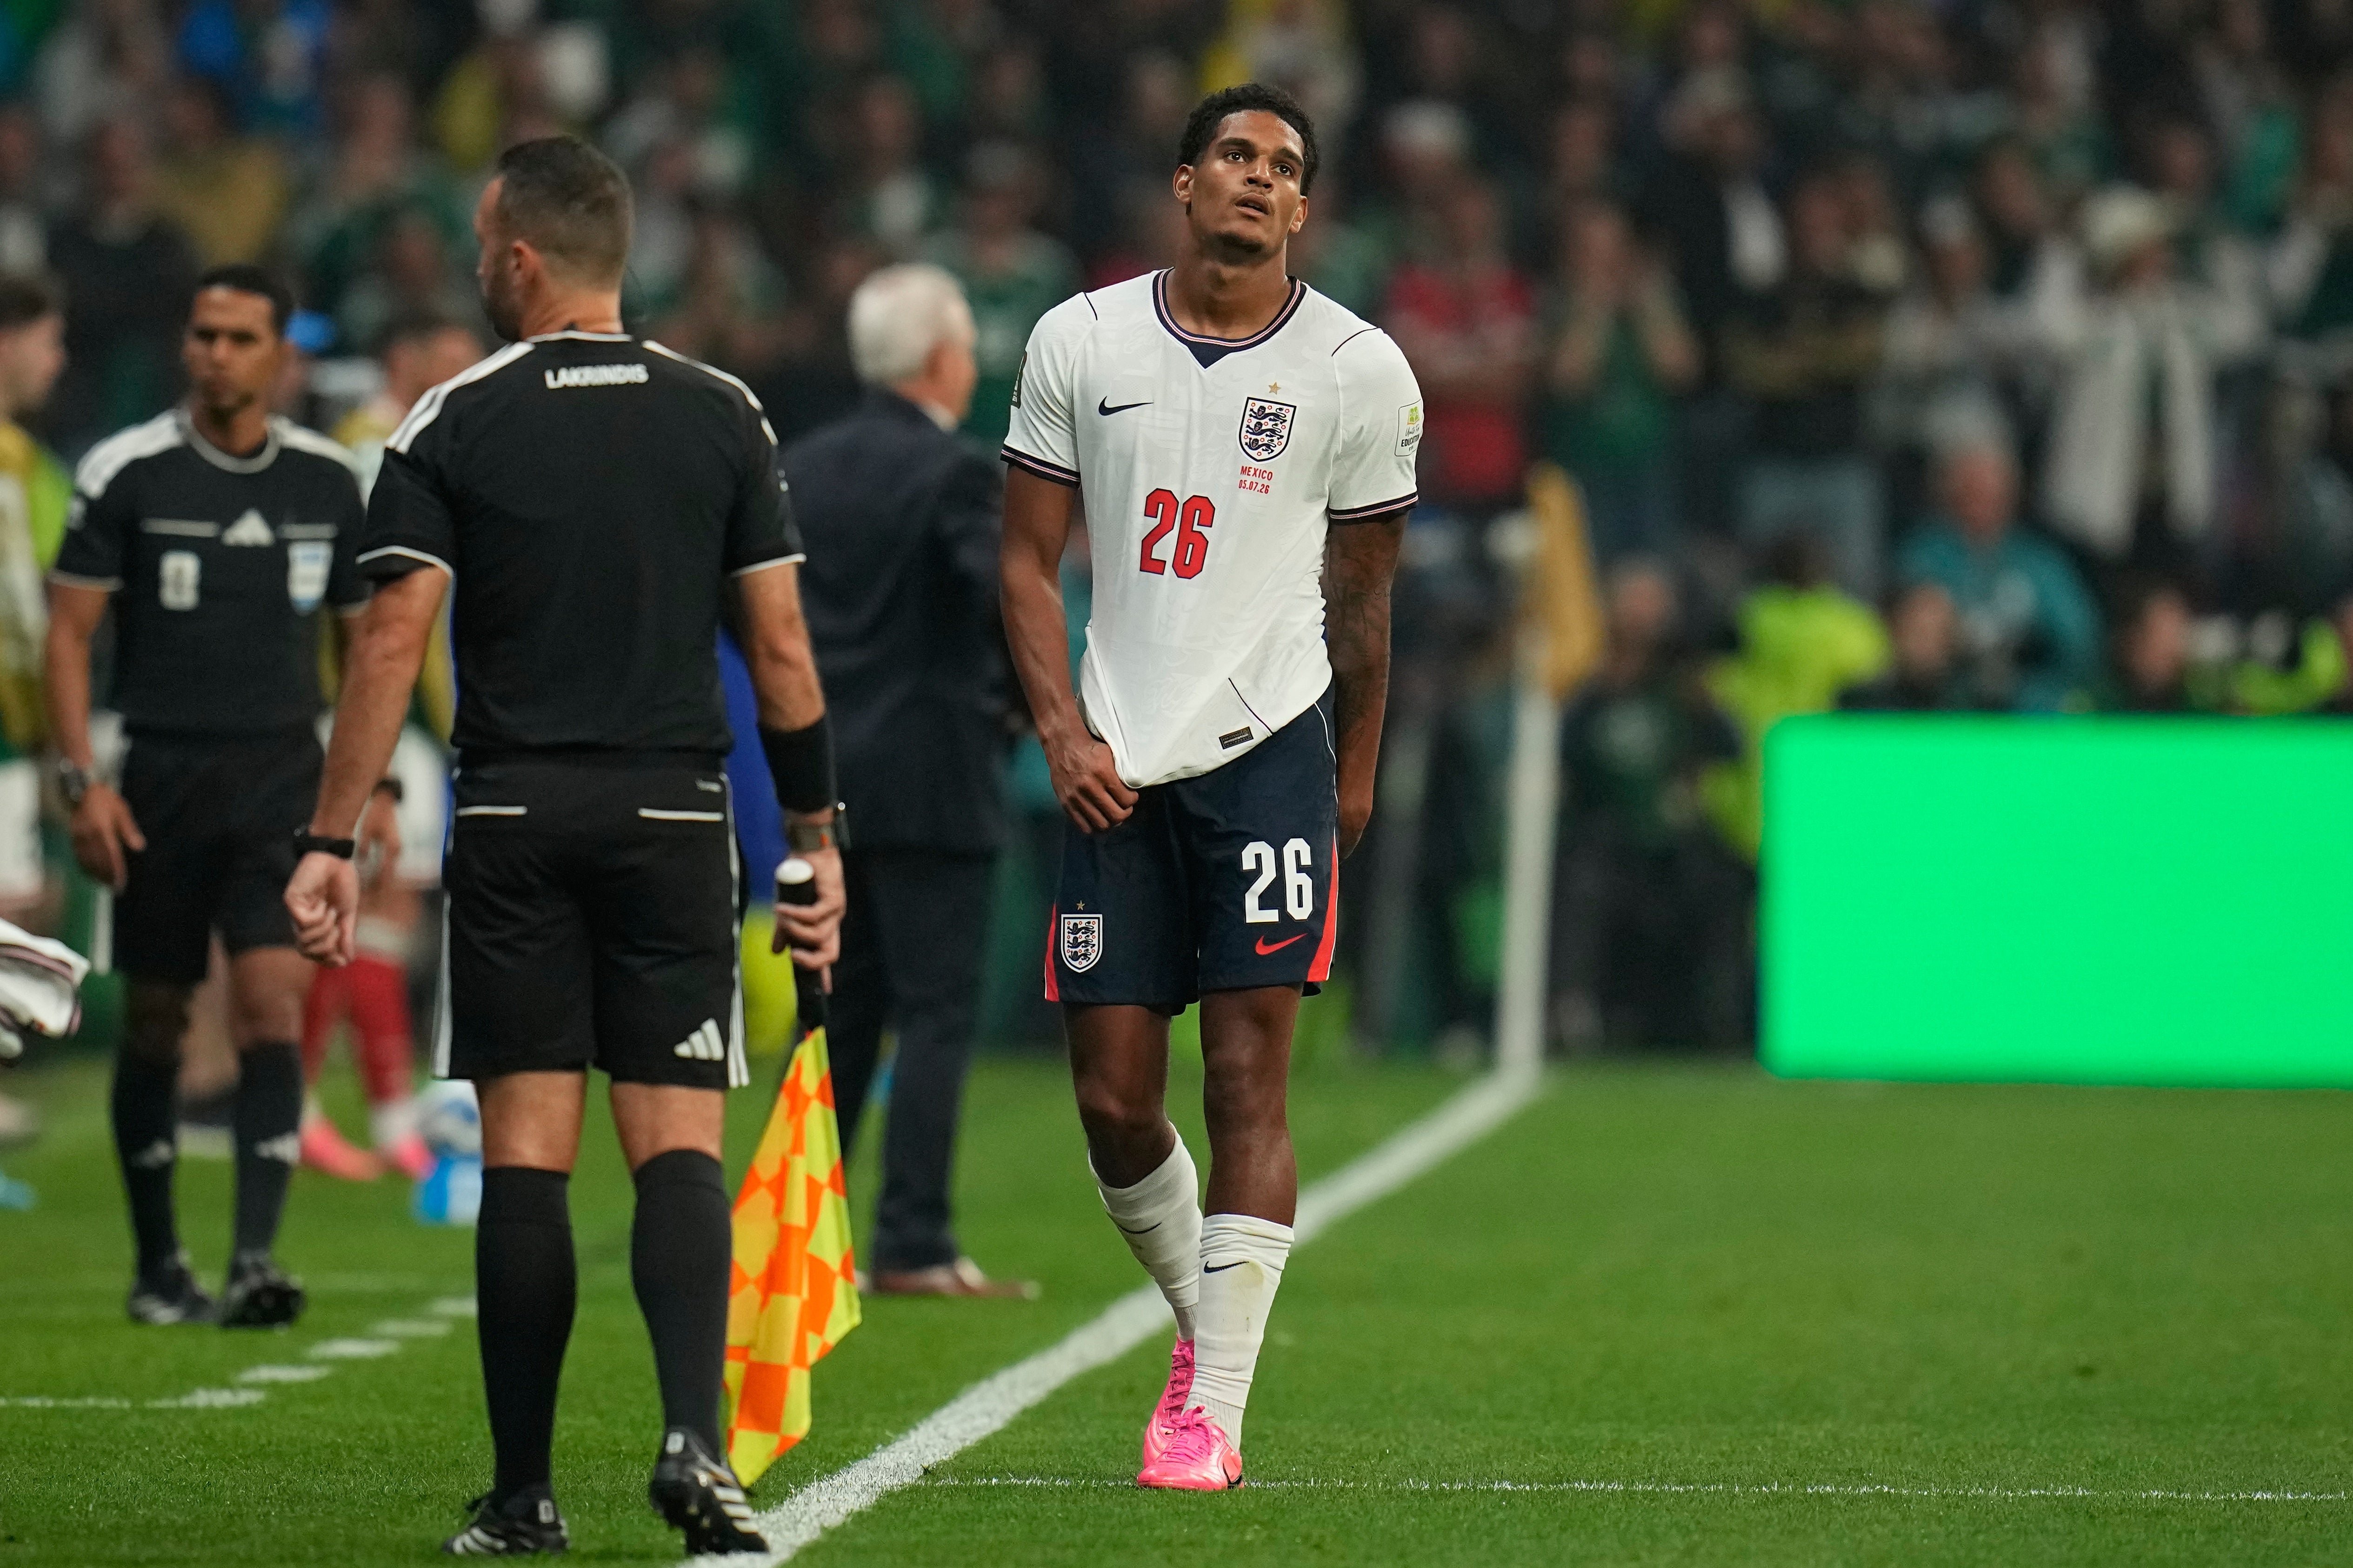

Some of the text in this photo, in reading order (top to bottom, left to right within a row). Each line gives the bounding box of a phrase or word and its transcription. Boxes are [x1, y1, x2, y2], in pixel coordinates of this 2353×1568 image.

[1238, 479, 1270, 494] 05.07.26
[1240, 465, 1273, 481] MEXICO
[1140, 488, 1215, 579] 26
[1241, 837, 1313, 924] 26
